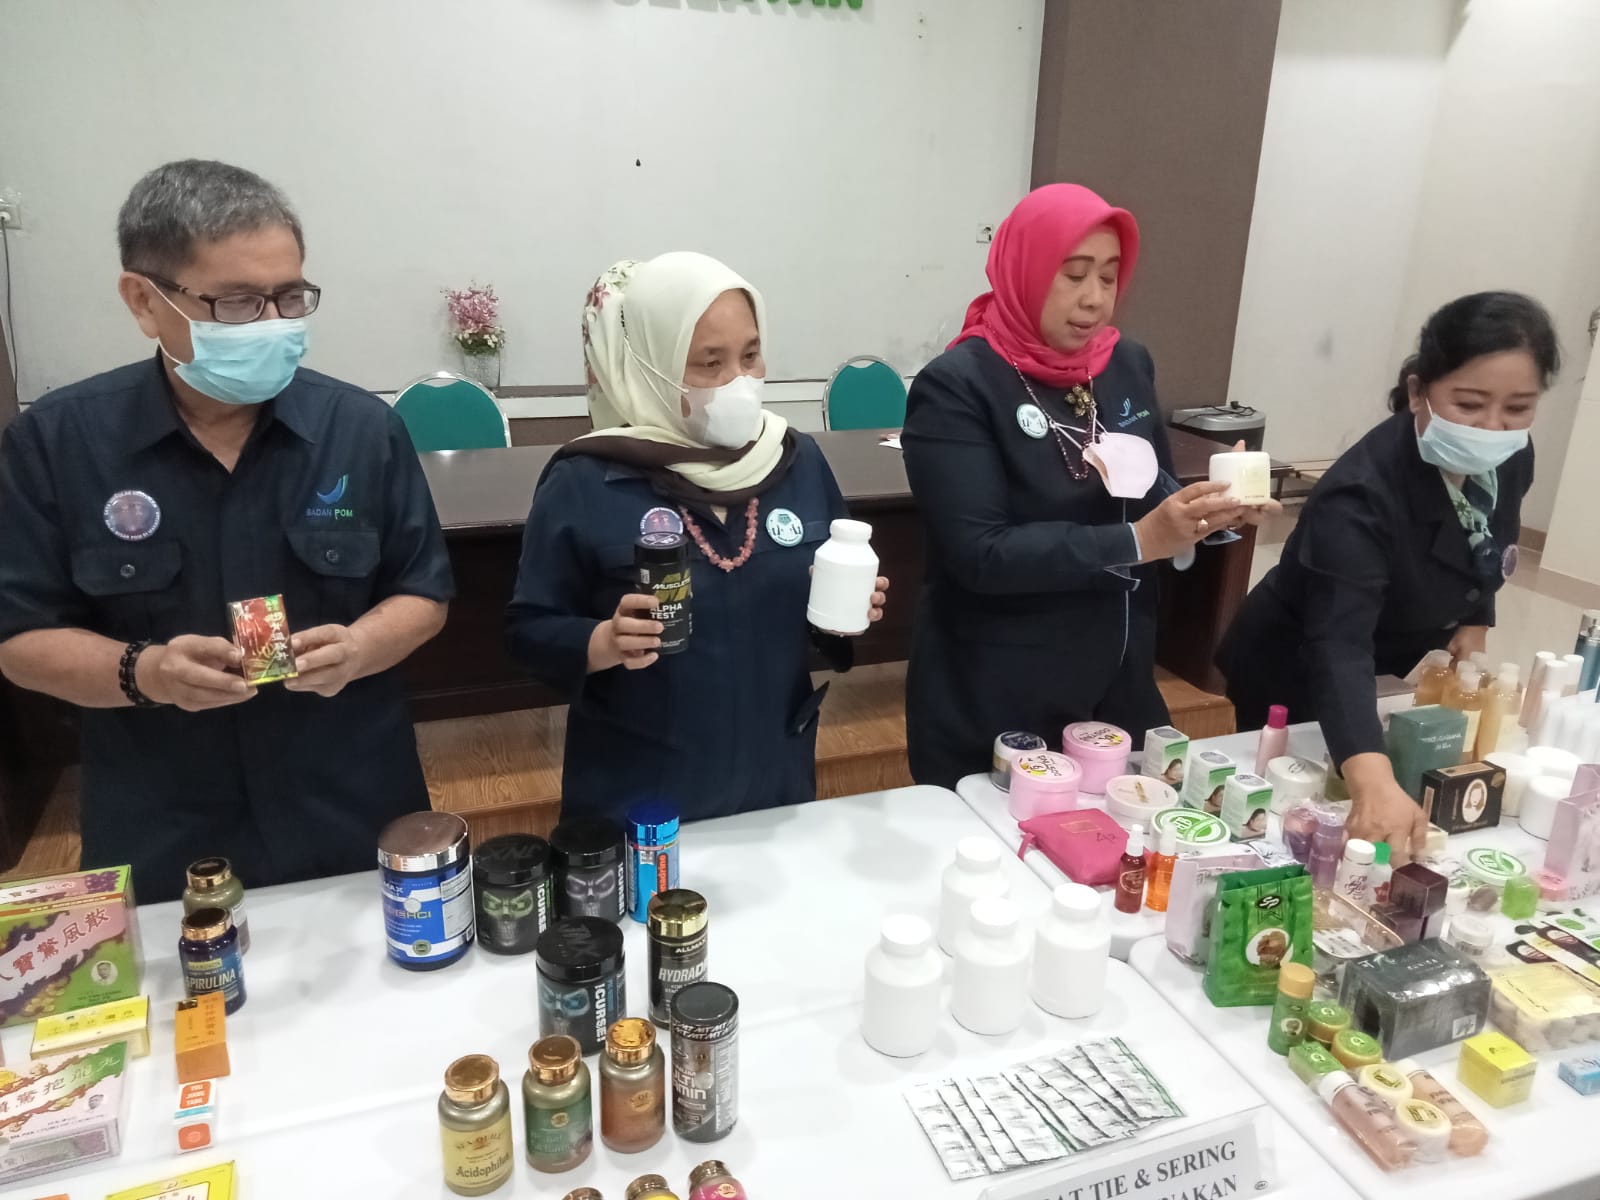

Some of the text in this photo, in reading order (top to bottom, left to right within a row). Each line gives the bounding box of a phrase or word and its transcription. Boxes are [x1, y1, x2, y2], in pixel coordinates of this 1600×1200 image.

[334, 508, 353, 520] POM
[650, 612, 676, 620] TEST
[1089, 1175, 1128, 1200] TIE
[1134, 1168, 1151, 1190] &
[1156, 1141, 1236, 1182] SERING
